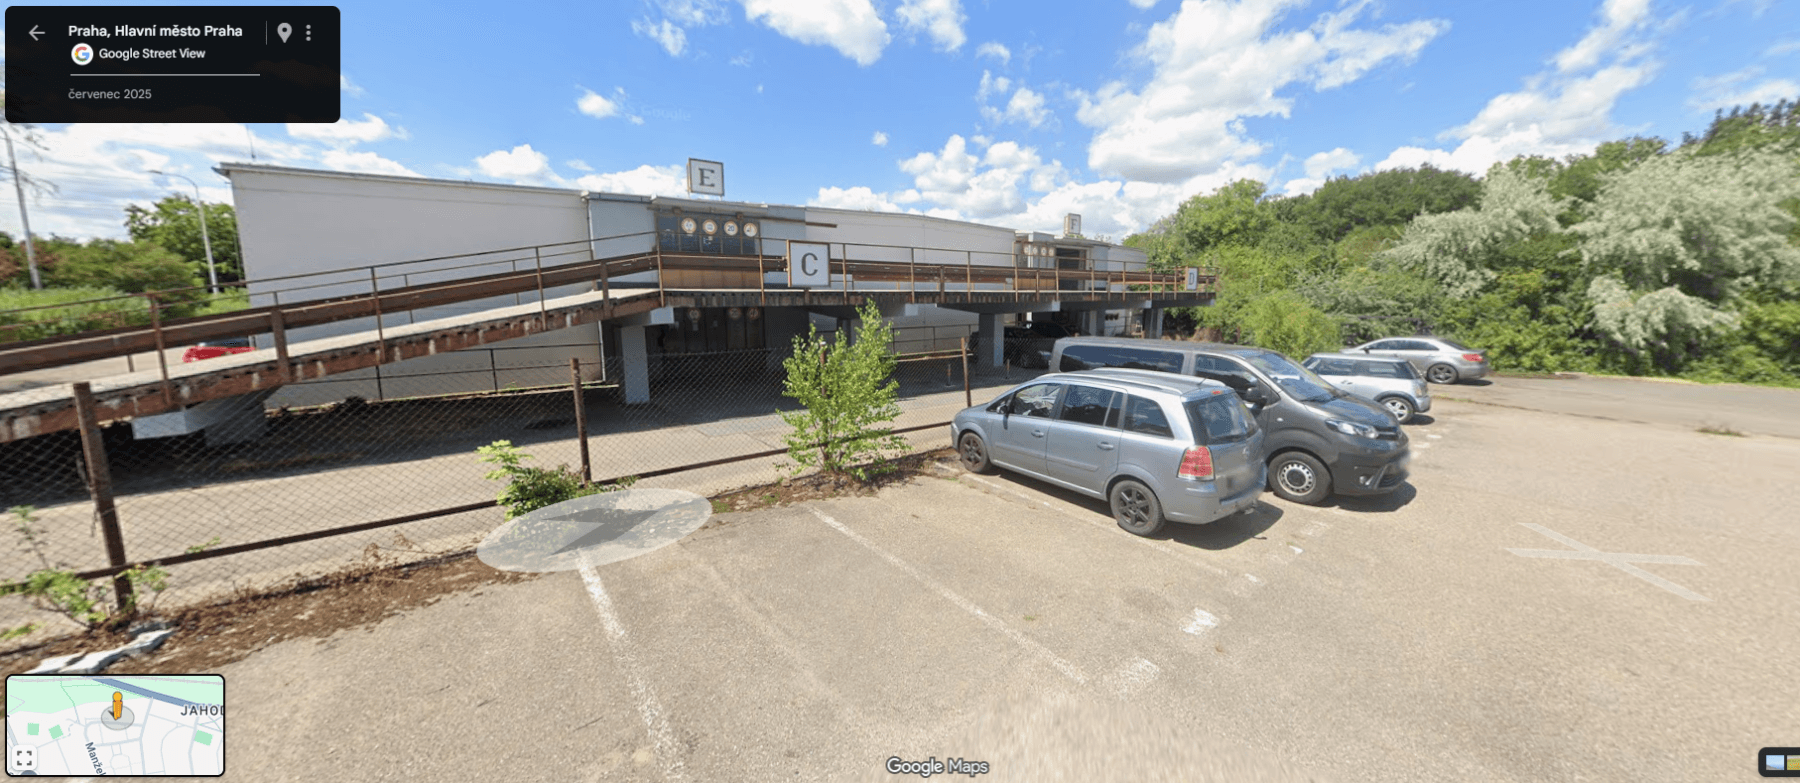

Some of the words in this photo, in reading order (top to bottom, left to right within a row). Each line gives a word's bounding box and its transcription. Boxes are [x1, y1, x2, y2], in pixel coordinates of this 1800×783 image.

[698, 168, 715, 187] E
[801, 252, 818, 276] C
[1189, 272, 1195, 285] D
